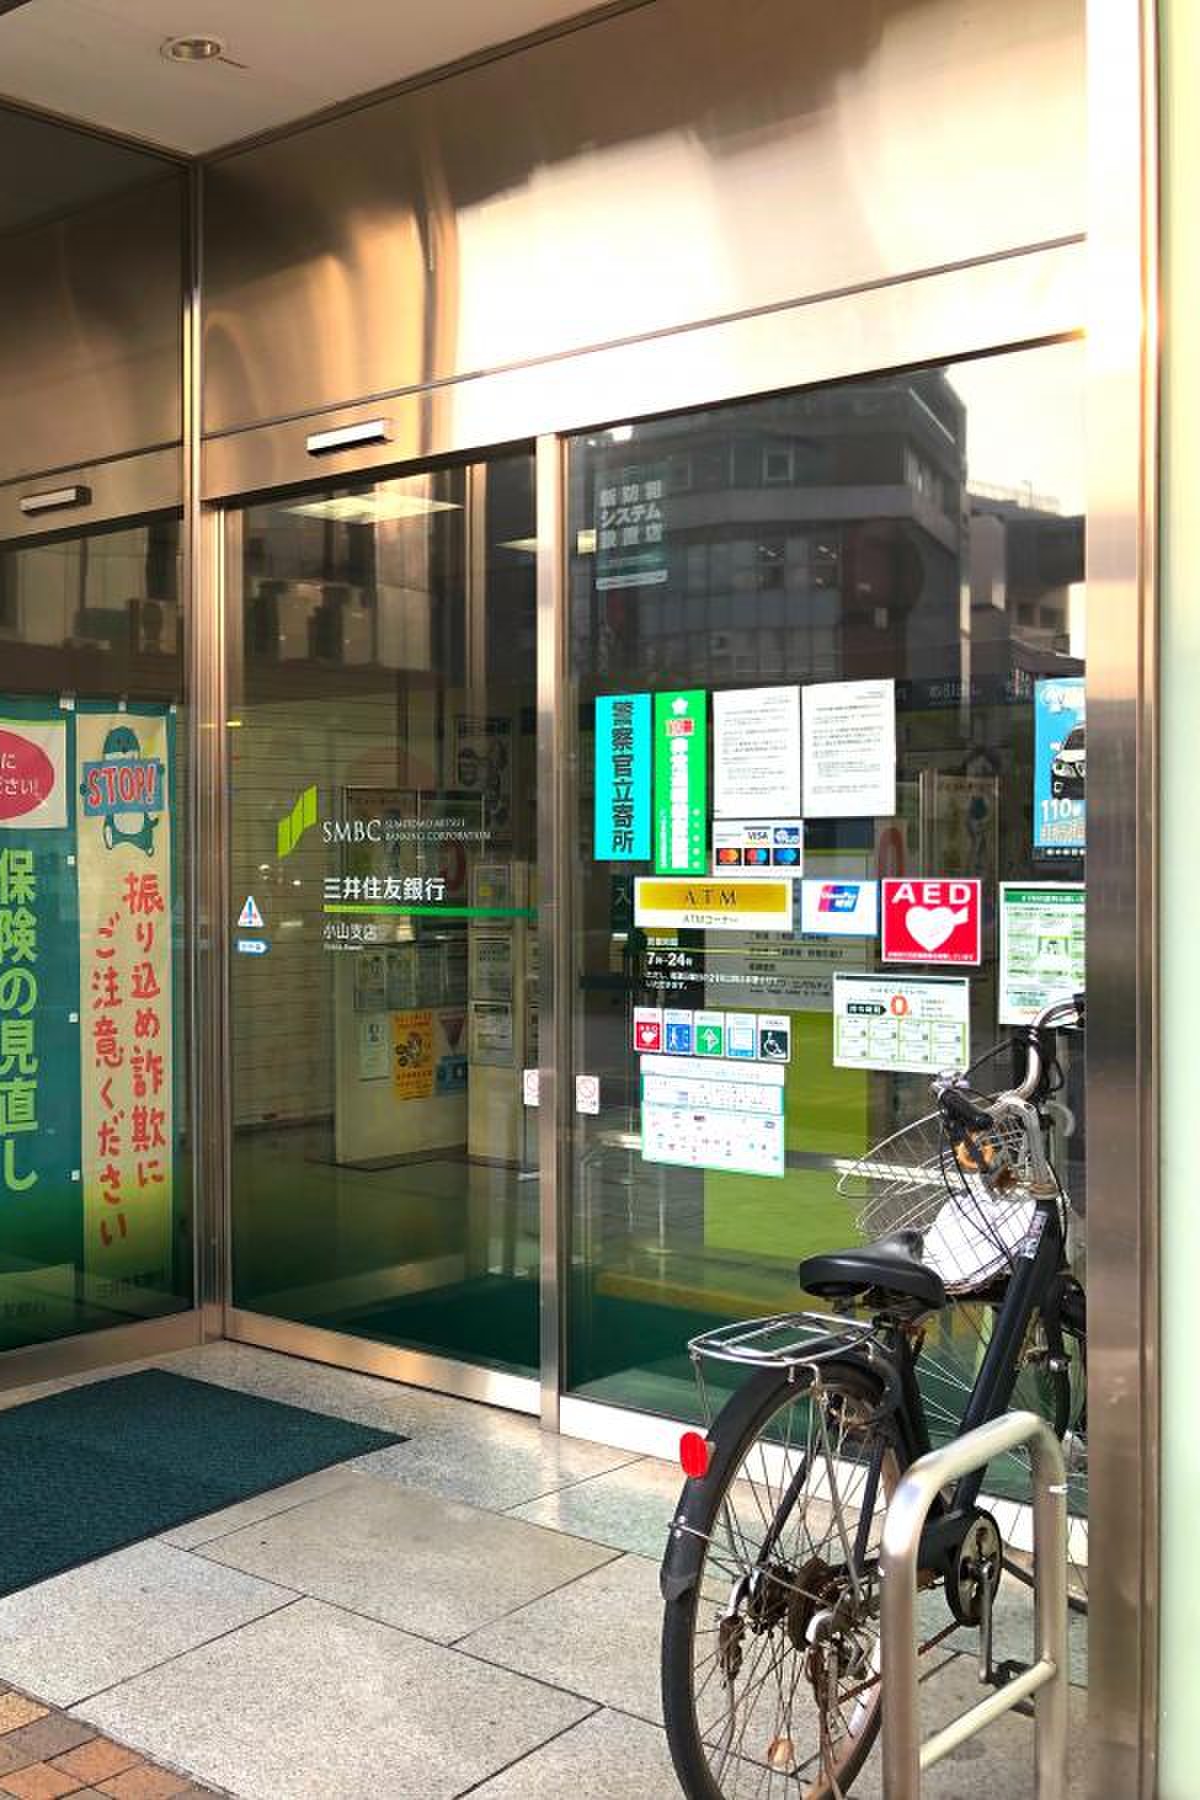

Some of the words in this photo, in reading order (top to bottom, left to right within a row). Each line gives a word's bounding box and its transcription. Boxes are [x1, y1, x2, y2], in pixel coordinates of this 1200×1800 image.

[601, 503, 660, 528] システム
[88, 764, 157, 808] STOP!
[323, 818, 382, 843] SMBC
[323, 876, 446, 901] 三井住友銀行
[891, 882, 972, 906] AED
[322, 921, 378, 941] 小山支店
[122, 871, 166, 1188] 振り込め詐欺に
[91, 911, 126, 1248] ご注意ください
